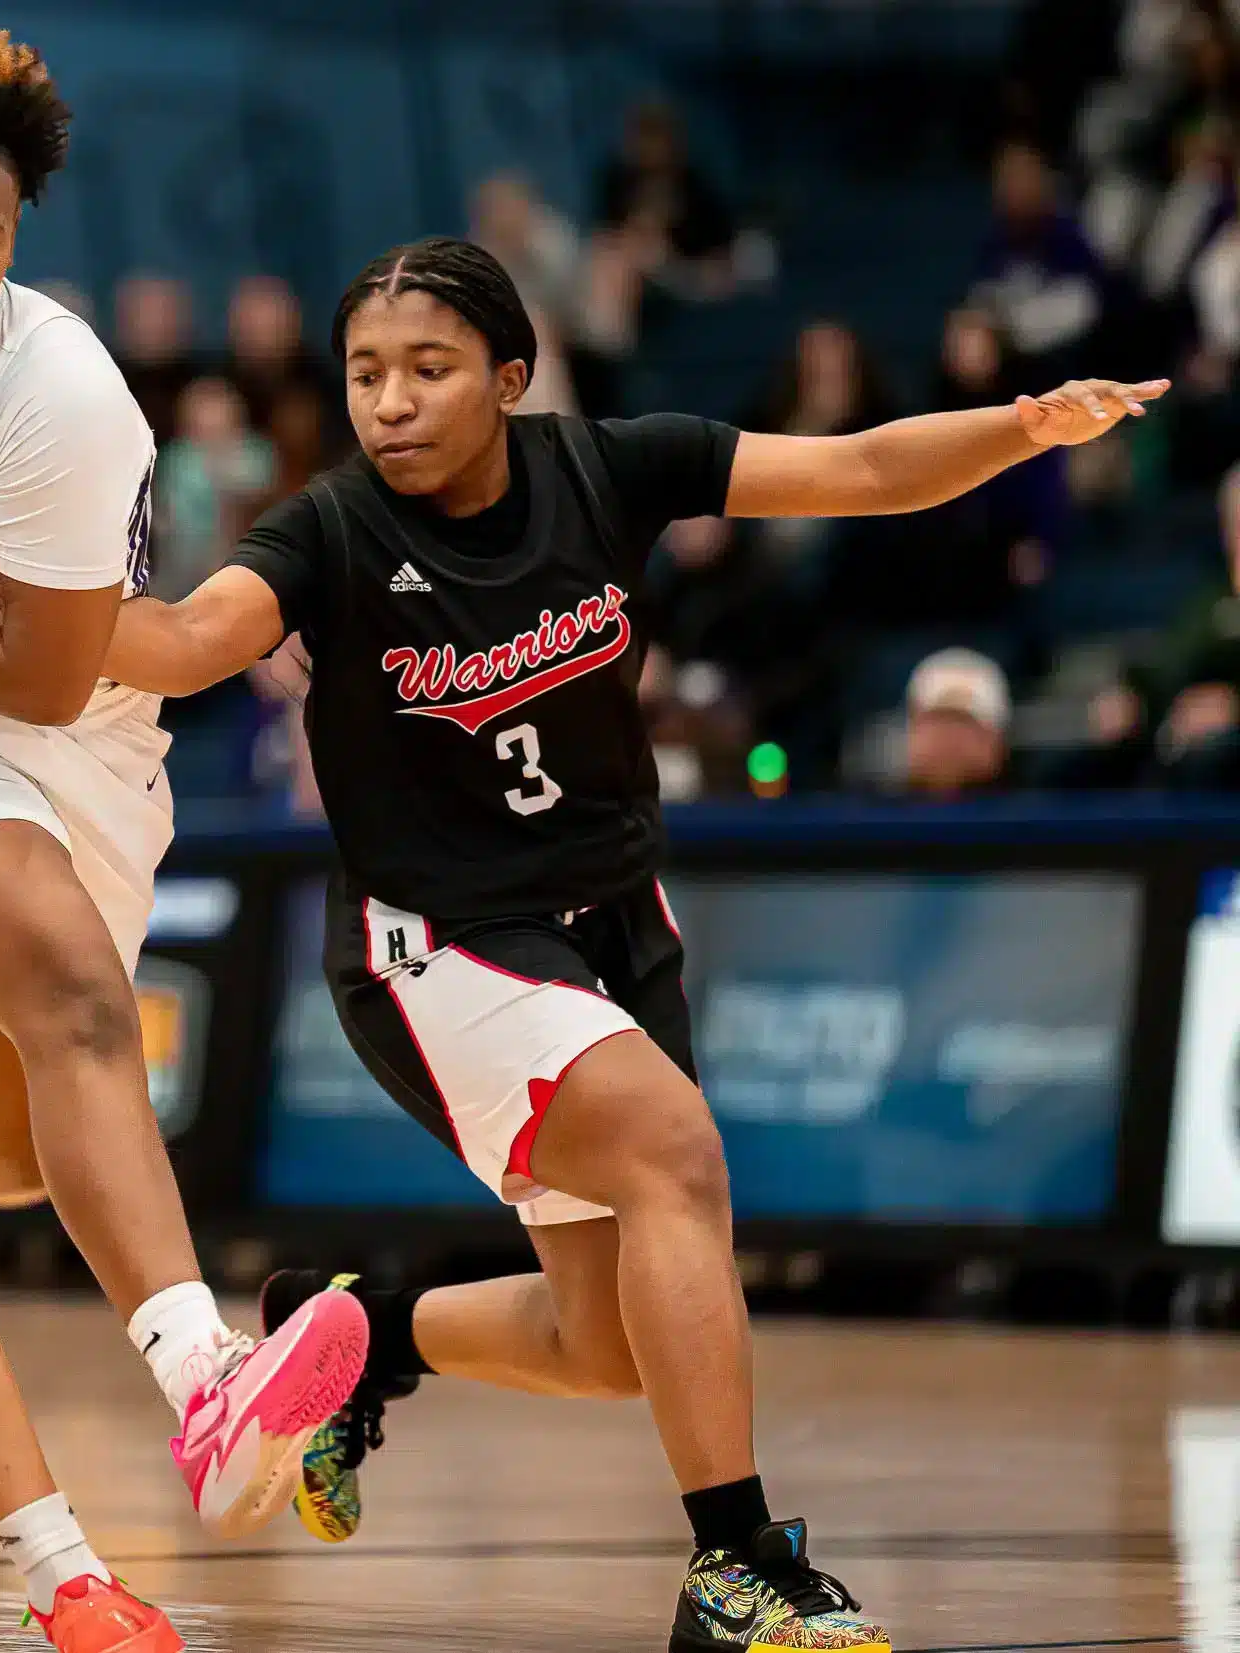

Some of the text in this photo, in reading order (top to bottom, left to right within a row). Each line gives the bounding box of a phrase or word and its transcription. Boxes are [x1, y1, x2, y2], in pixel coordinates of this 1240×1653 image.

[390, 581, 432, 592] adidas
[382, 583, 628, 700] Warriors
[495, 723, 563, 816] 3
